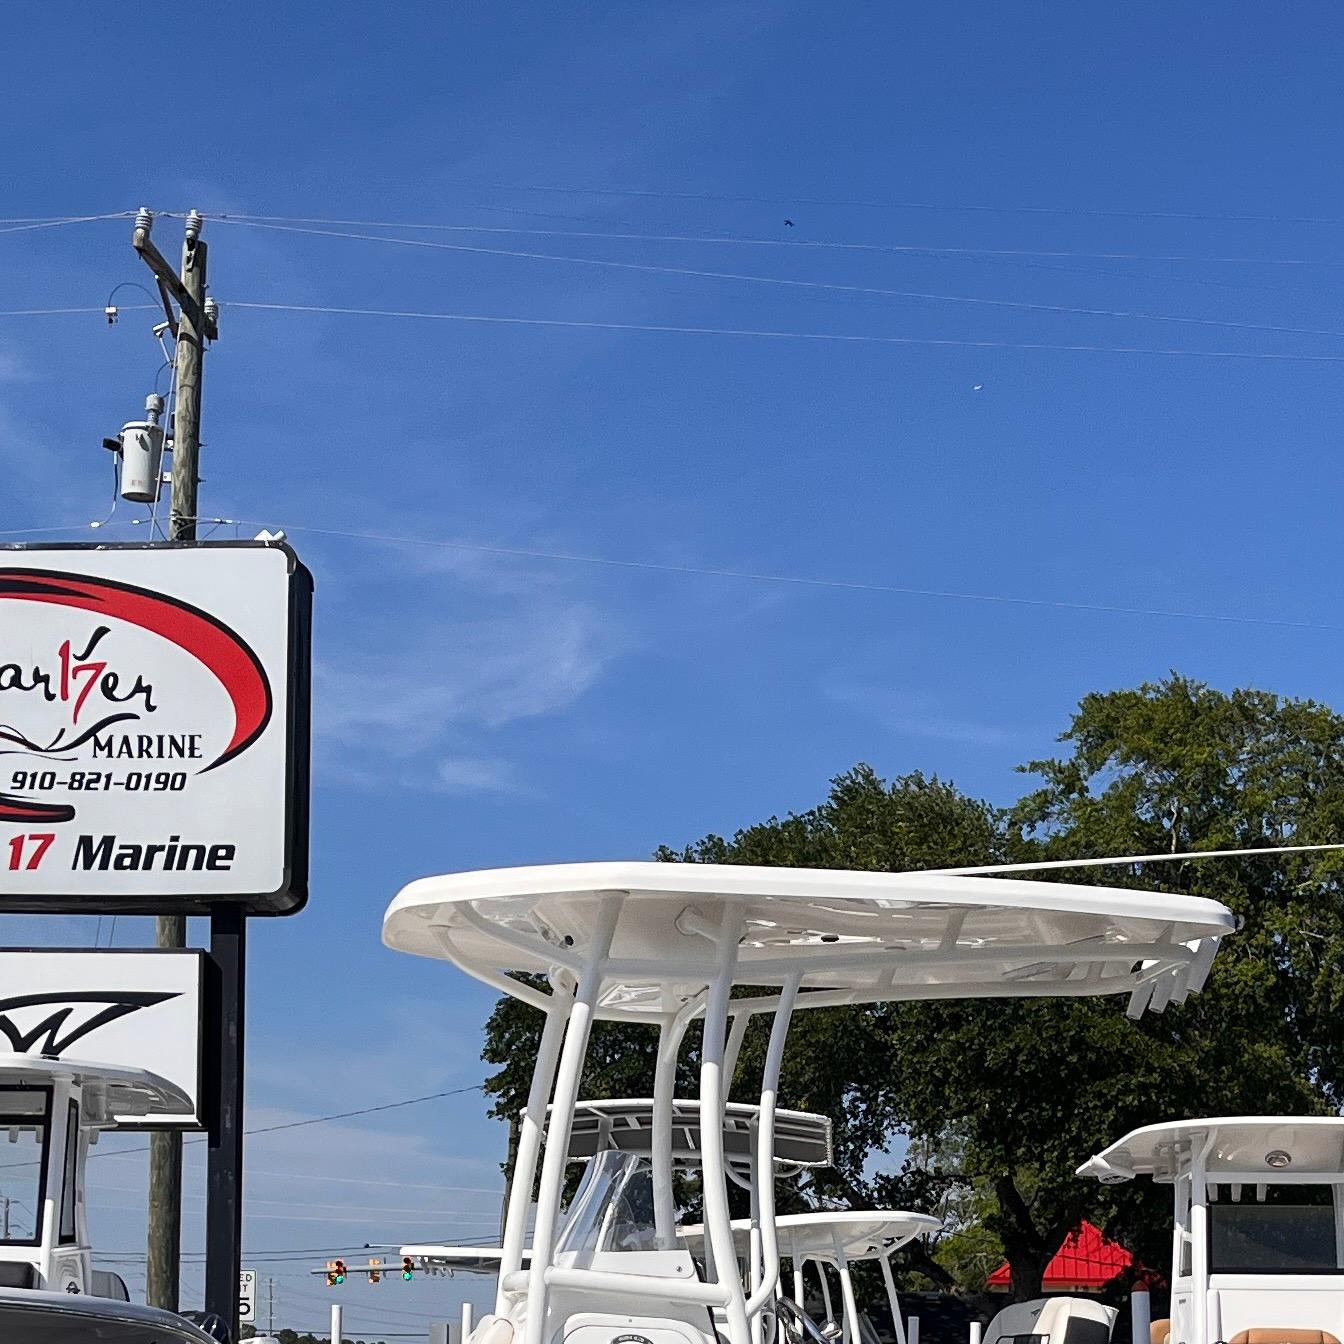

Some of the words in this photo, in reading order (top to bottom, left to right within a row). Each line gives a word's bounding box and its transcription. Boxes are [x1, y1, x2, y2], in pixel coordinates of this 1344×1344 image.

[92, 733, 203, 760] MARINE
[10, 771, 187, 792] 910-821-0190
[8, 833, 56, 871] 17
[71, 835, 236, 872] Marine
